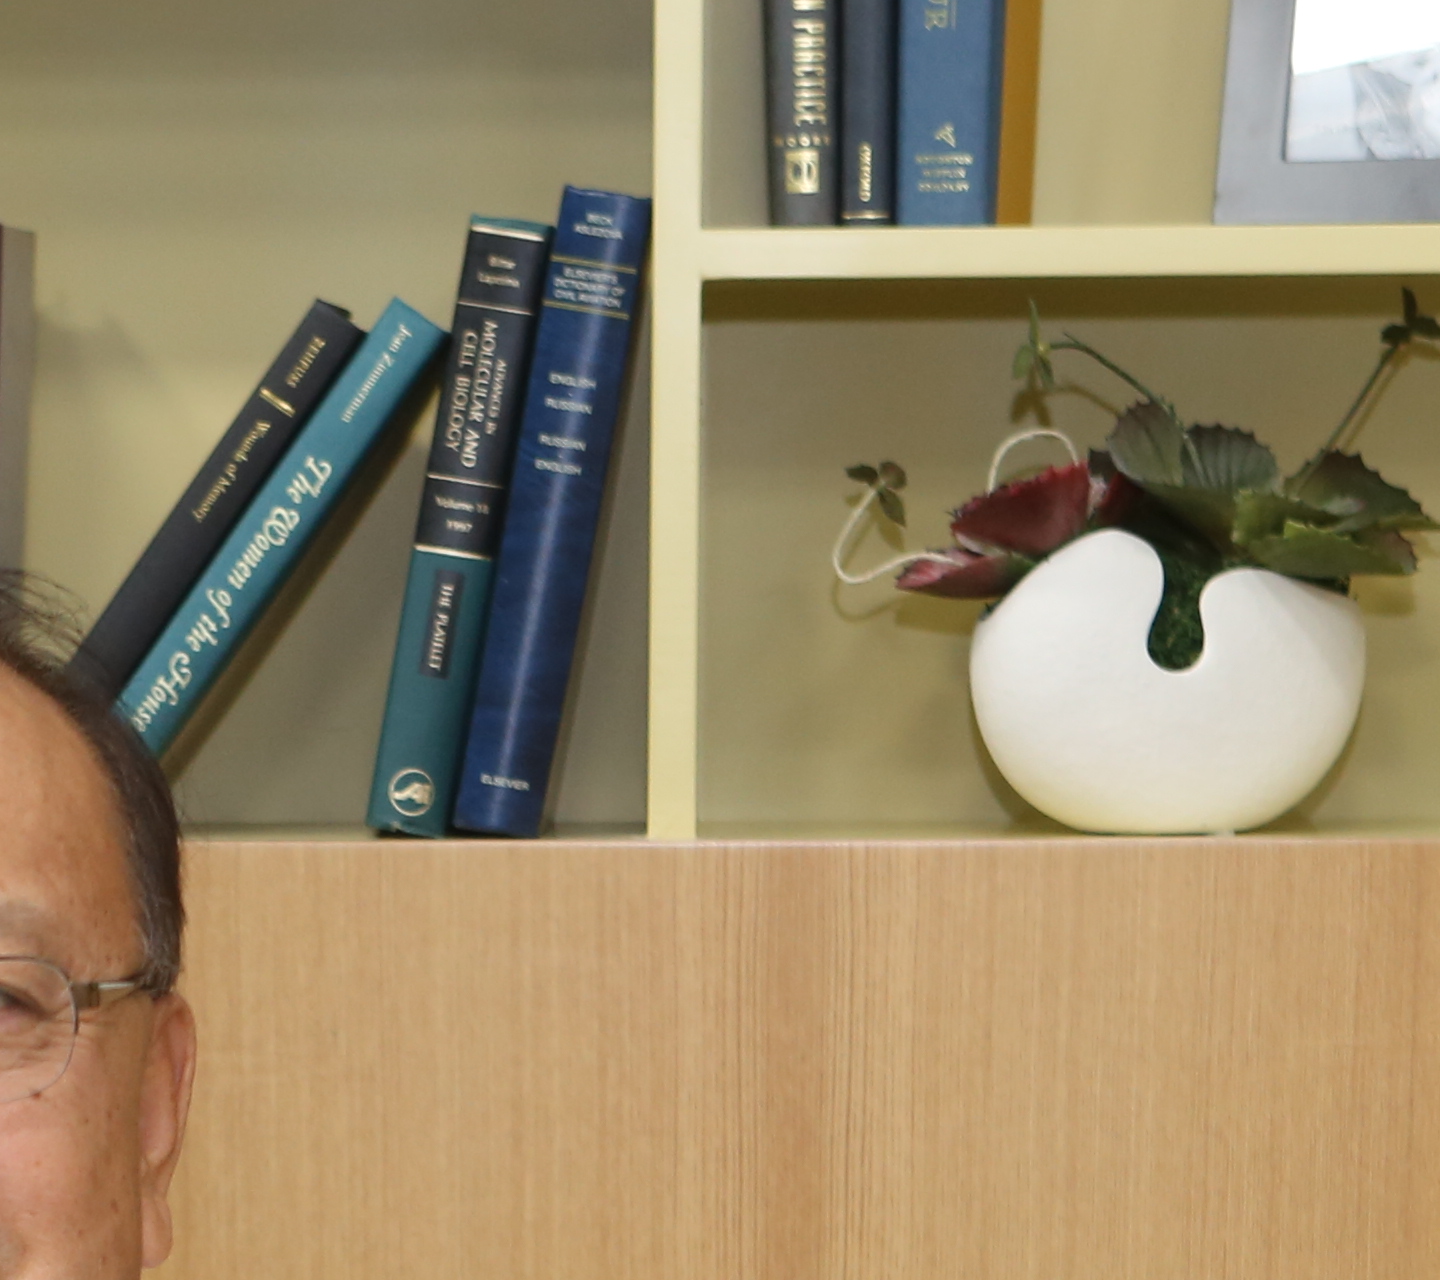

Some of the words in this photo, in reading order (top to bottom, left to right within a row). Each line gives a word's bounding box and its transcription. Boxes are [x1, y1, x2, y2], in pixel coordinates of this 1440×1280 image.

[790, 18, 828, 126] PRACTICE
[385, 322, 414, 355] Jean
[456, 328, 479, 370] CELL
[339, 350, 396, 426] Zimmerman
[466, 318, 500, 424] MOLECULAR
[486, 358, 508, 419] ADVANCES
[547, 371, 598, 389] ENGLISH
[442, 372, 471, 453] BIOLOGY
[483, 420, 497, 436] IN
[543, 396, 594, 414] RUSSIAN
[229, 413, 273, 466] Wounds
[458, 426, 482, 469] AND
[537, 433, 588, 451] RUSSIAN
[217, 458, 241, 483] of
[281, 451, 337, 512] The
[532, 458, 582, 476] ENGLISH
[188, 473, 231, 526] Memory
[223, 500, 303, 597] Women
[194, 582, 244, 630] of
[436, 581, 455, 609] THE
[181, 611, 227, 659] the
[426, 612, 450, 671] PLATELET
[123, 647, 203, 741] House
